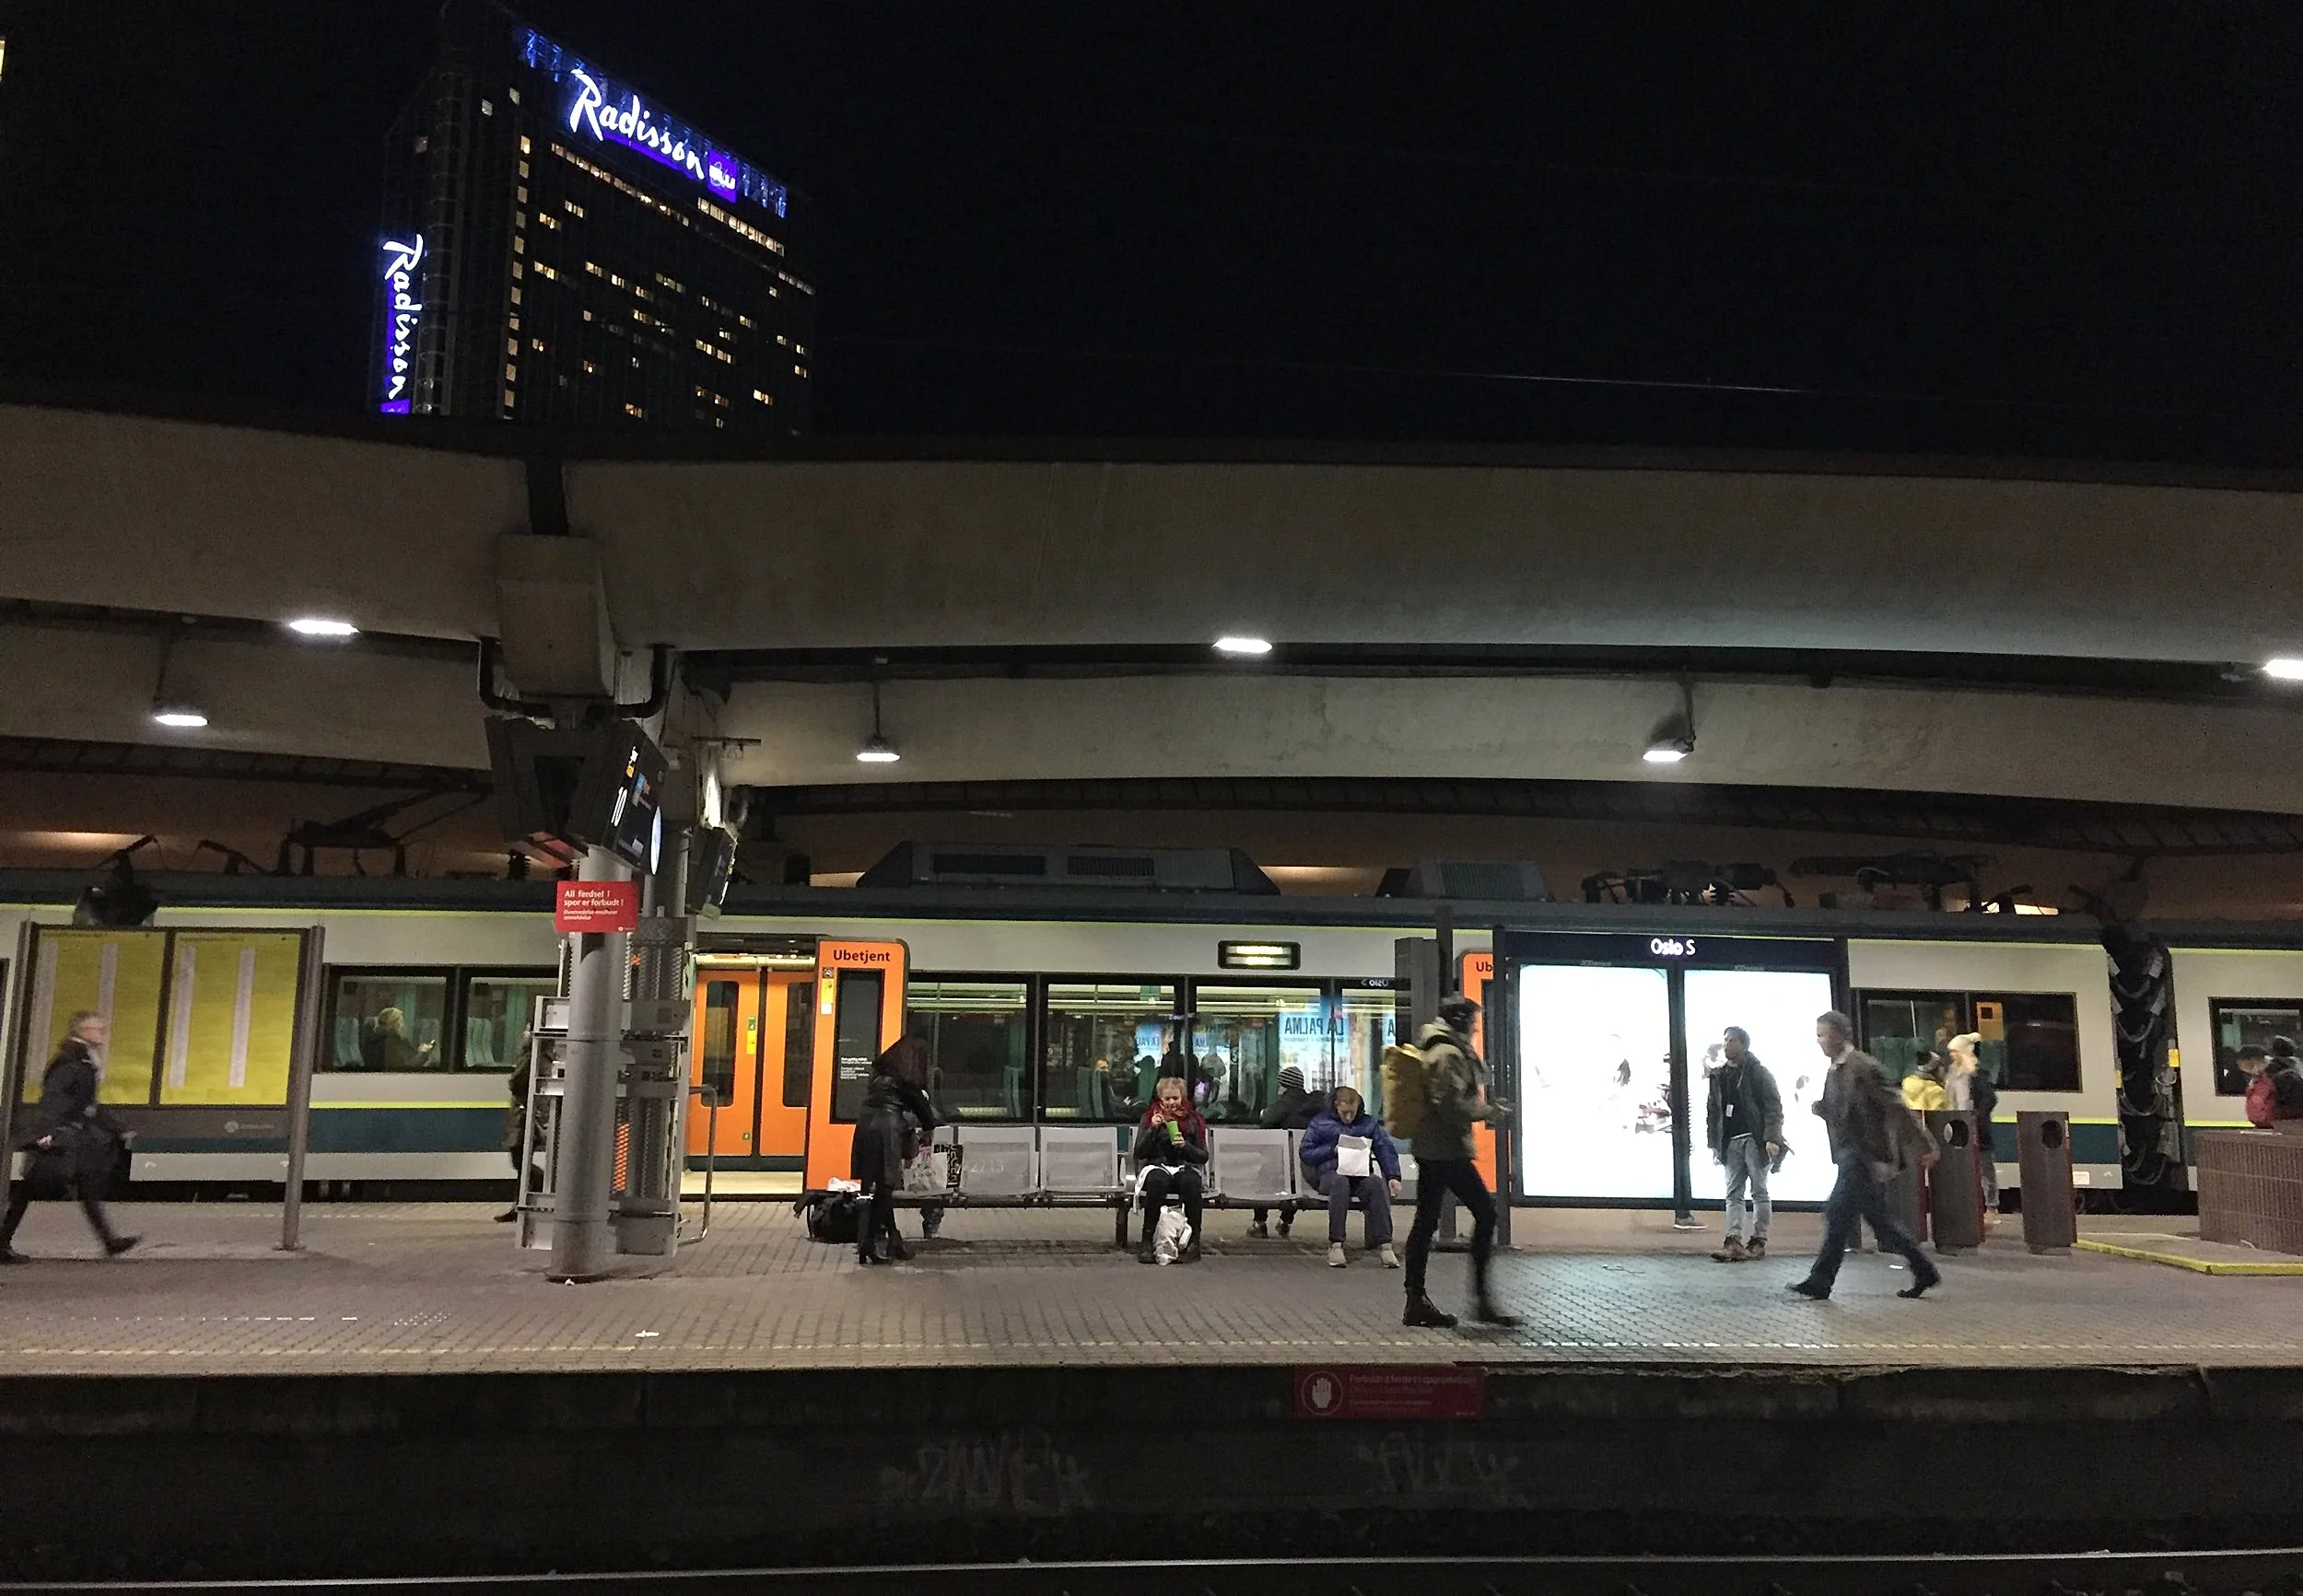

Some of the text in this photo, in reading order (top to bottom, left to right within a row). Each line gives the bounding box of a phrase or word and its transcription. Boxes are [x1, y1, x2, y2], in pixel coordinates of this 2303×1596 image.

[569, 68, 705, 180] Radisson
[382, 233, 424, 400] Radisson
[564, 890, 576, 898] All
[564, 899, 581, 907] spor
[1650, 938, 1696, 956] Oslo S
[833, 949, 891, 964] Ubetjent
